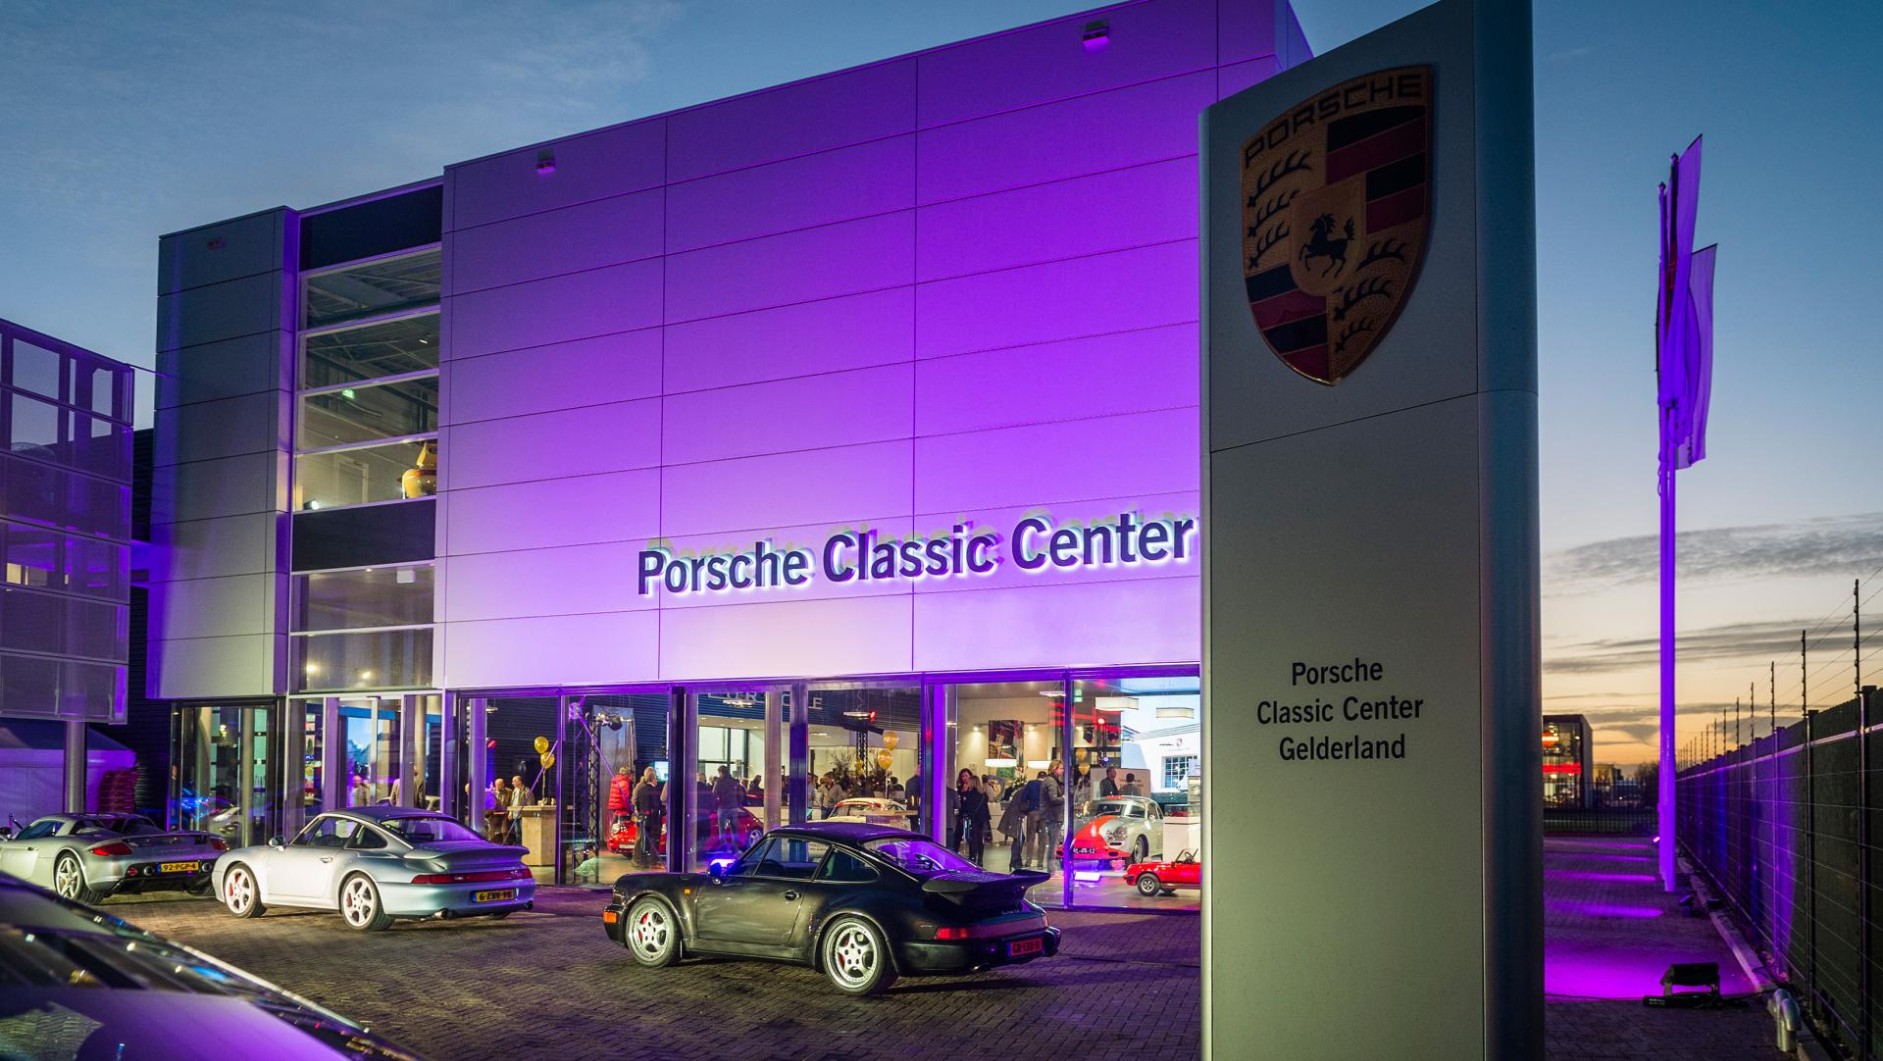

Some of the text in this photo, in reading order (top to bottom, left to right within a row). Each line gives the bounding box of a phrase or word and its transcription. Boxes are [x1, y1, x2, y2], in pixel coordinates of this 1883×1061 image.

[1244, 74, 1422, 168] PORSCHE
[638, 512, 1196, 595] Porsche Classic Center
[1291, 657, 1383, 686] Porsche
[1257, 695, 1424, 725] Classic Center
[1279, 733, 1406, 761] Gelderland
